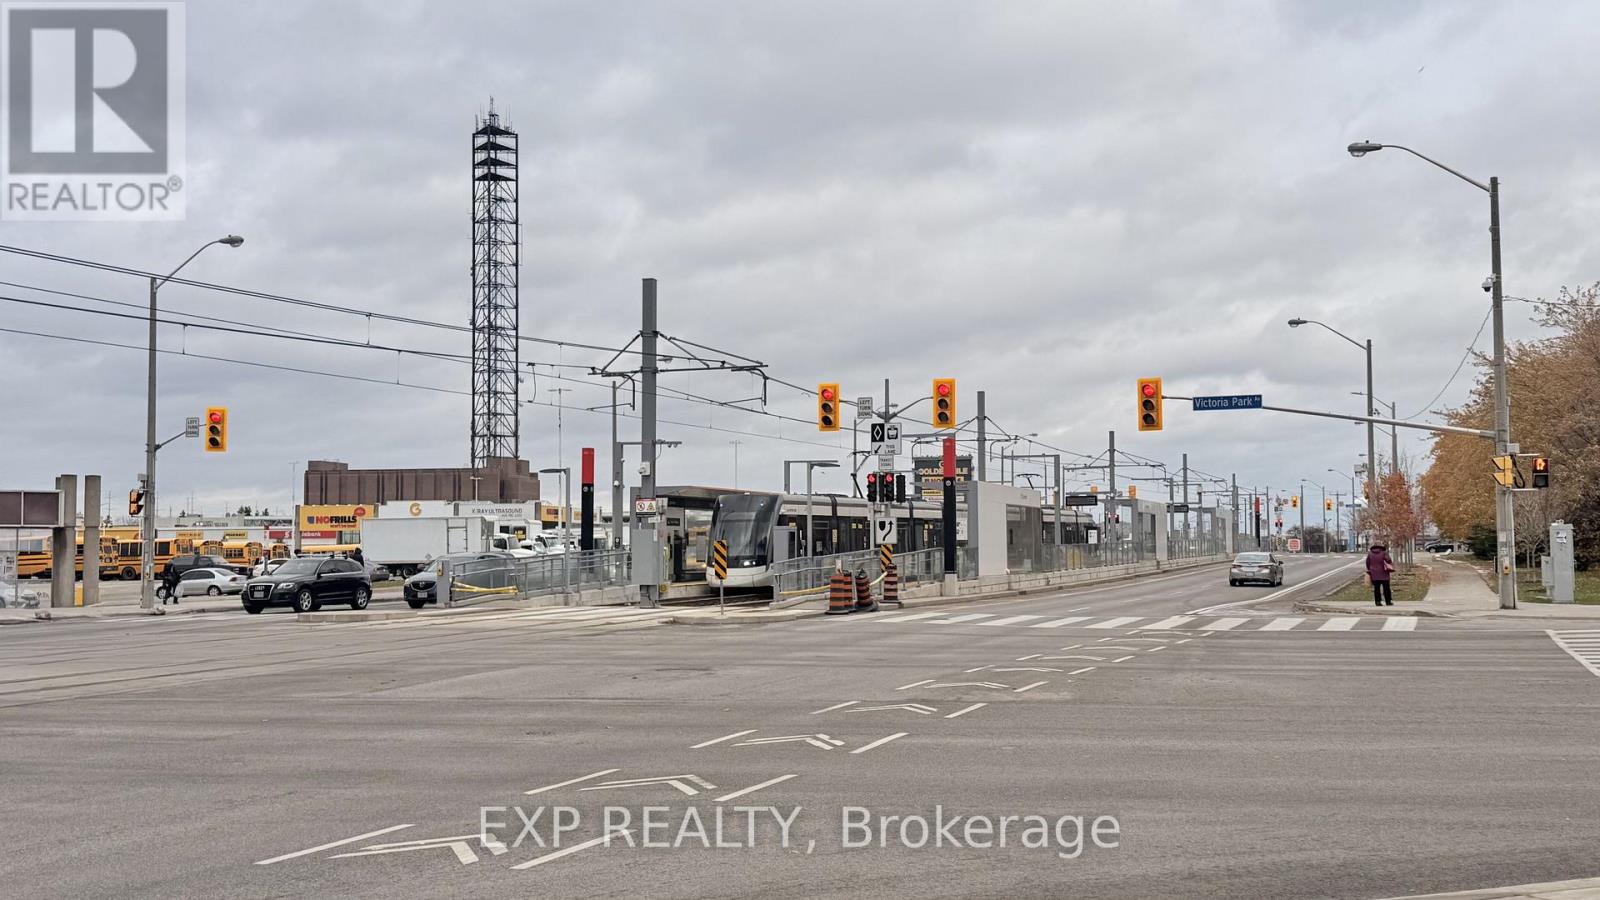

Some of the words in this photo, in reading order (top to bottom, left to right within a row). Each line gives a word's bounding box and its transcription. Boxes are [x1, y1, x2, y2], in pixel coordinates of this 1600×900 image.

[1194, 398, 1229, 408] Victoria
[1232, 397, 1252, 407] Park
[918, 467, 945, 475] GOLDE
